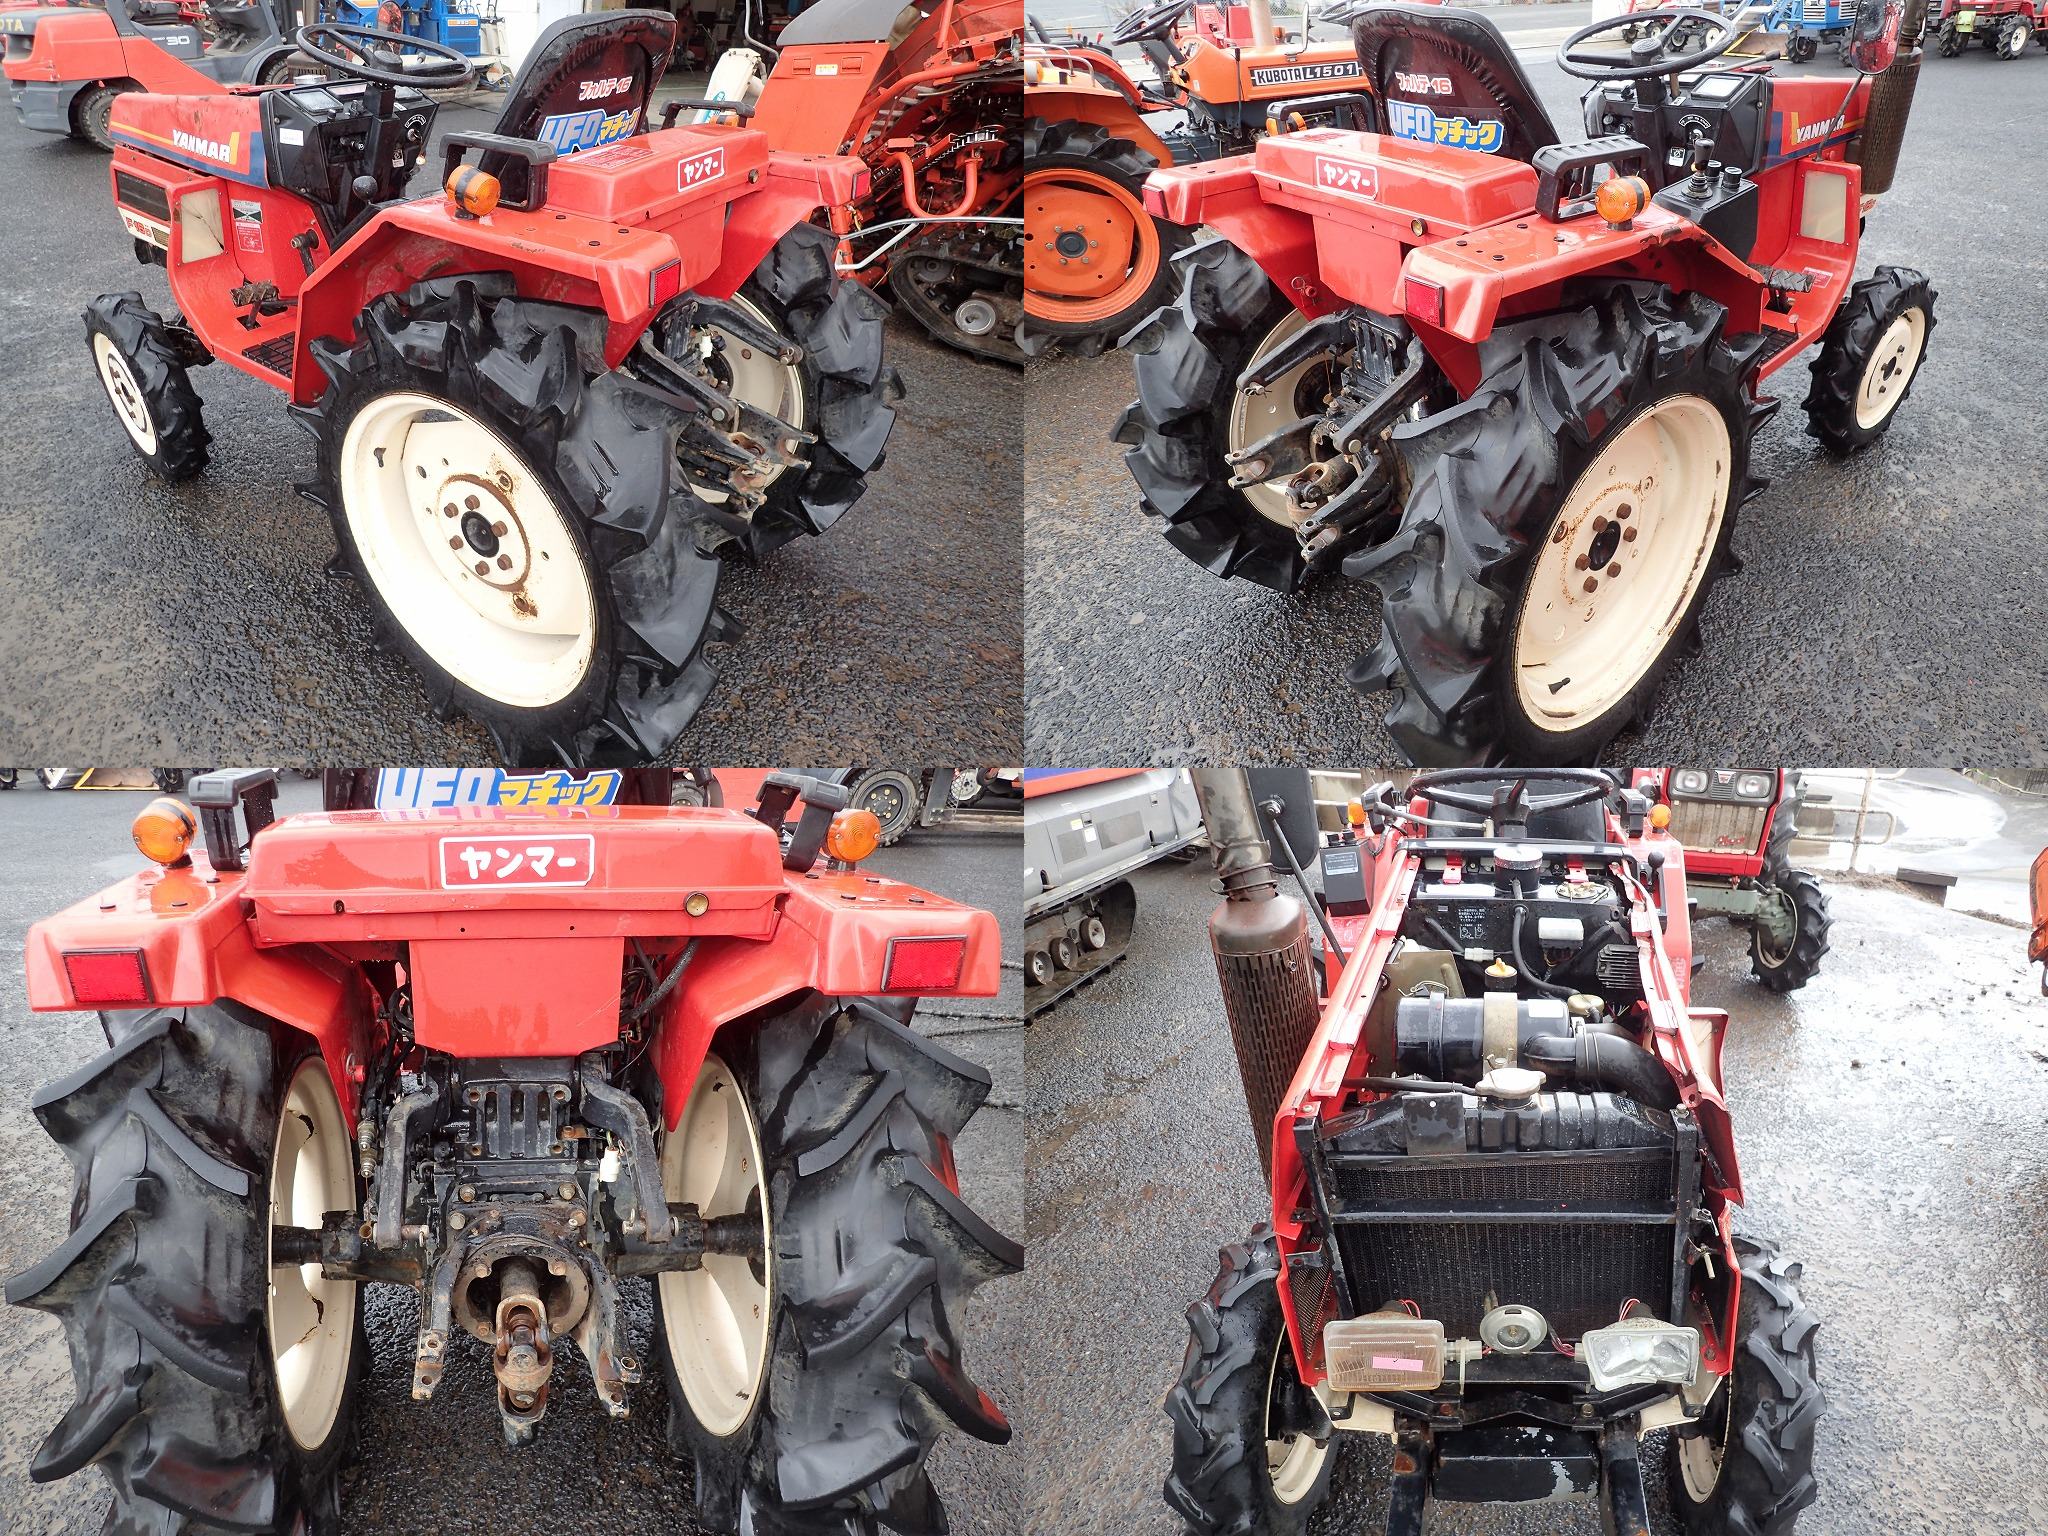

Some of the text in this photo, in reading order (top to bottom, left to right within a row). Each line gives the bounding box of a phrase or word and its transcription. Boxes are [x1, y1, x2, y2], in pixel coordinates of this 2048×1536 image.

[166, 35, 190, 45] 30
[1257, 63, 1355, 84] KUBOTA L1501
[1797, 115, 1845, 144] YANMR
[173, 129, 230, 163] YANMAR
[684, 156, 719, 184] ヤンマー
[1323, 162, 1371, 190] ヤンマー
[460, 845, 577, 880] ヤンマー
